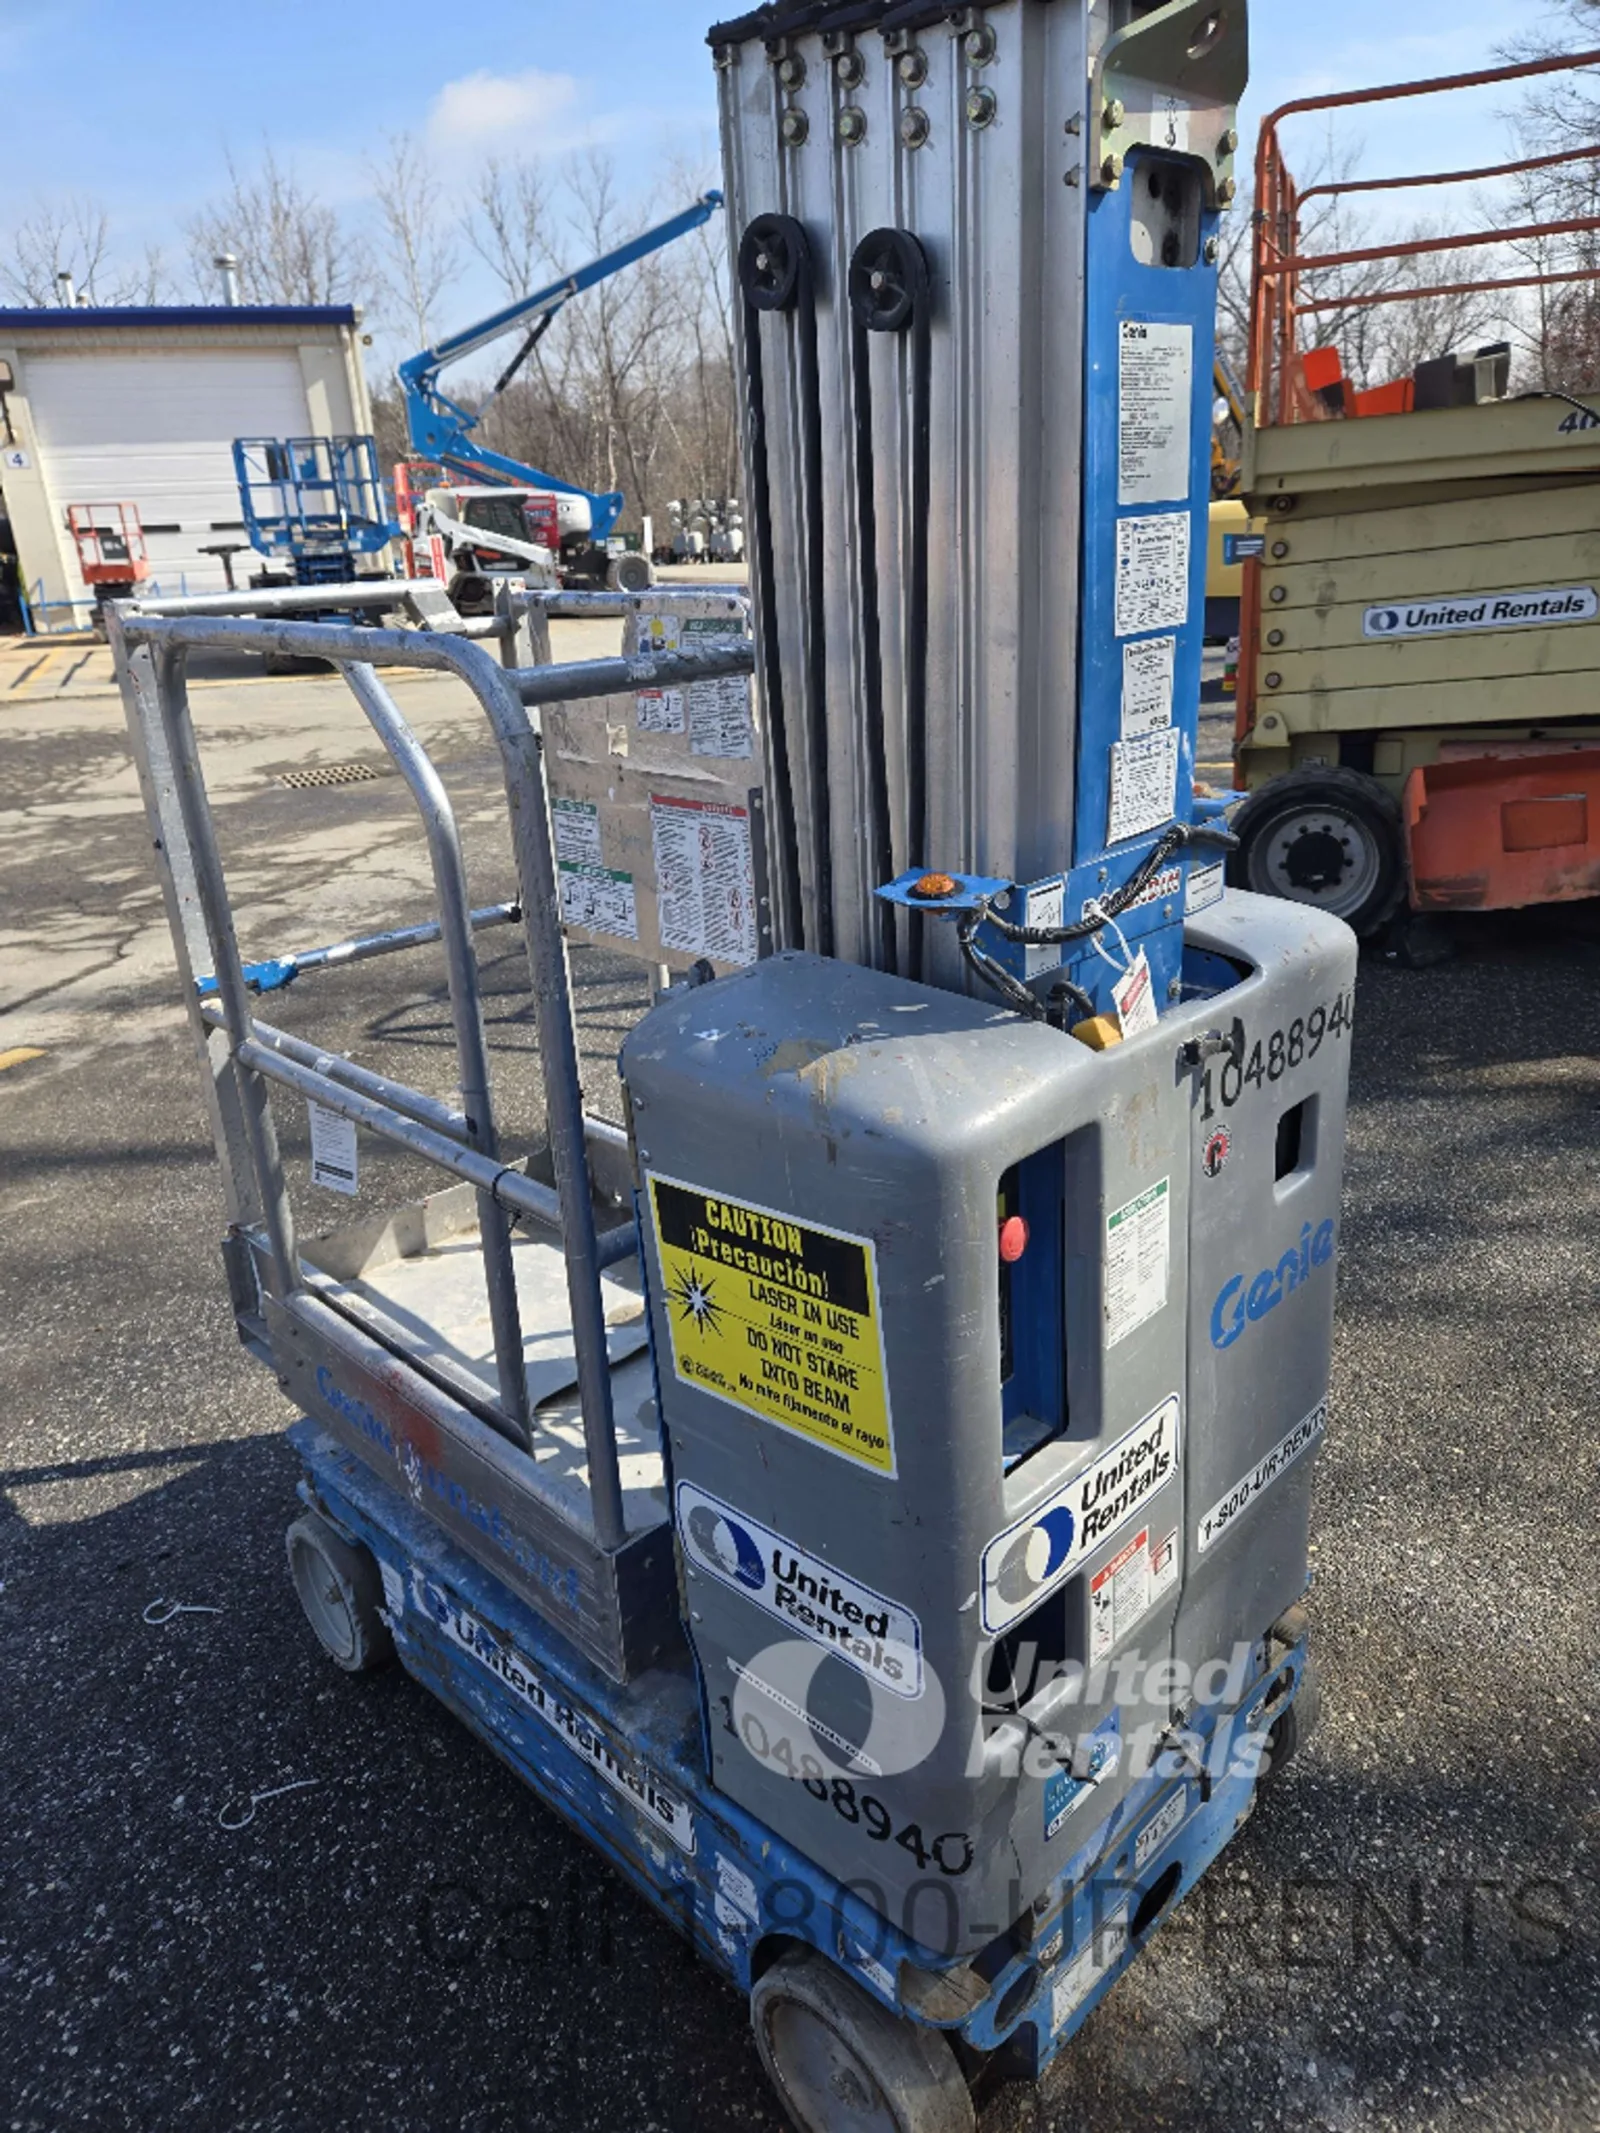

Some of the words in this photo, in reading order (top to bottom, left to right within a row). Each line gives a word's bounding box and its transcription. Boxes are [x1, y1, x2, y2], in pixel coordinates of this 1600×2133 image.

[12, 453, 24, 466] 4
[1405, 602, 1486, 628] United
[1491, 594, 1585, 620] Rentals
[705, 1200, 803, 1257] CAUTION
[748, 1278, 798, 1317] LASER
[802, 1299, 822, 1327] IN
[826, 1309, 860, 1341] USE
[1209, 1216, 1336, 1351] Genie
[745, 1326, 768, 1352] DO
[771, 1336, 801, 1367] NOT
[806, 1351, 860, 1391] STARE
[769, 1312, 801, 1337] Láser
[738, 1372, 754, 1391] No
[755, 1381, 781, 1403] mire
[783, 1393, 839, 1430] fijamente
[841, 1421, 854, 1436] el
[855, 1429, 885, 1449] rayo
[760, 1357, 800, 1391] INTO
[803, 1376, 852, 1415] BEAM
[1078, 1449, 1171, 1549] Rentals
[1080, 1416, 1165, 1512] United
[771, 1548, 890, 1640] United
[775, 1582, 904, 1682] Rentals
[711, 1695, 974, 1876] 10488940
